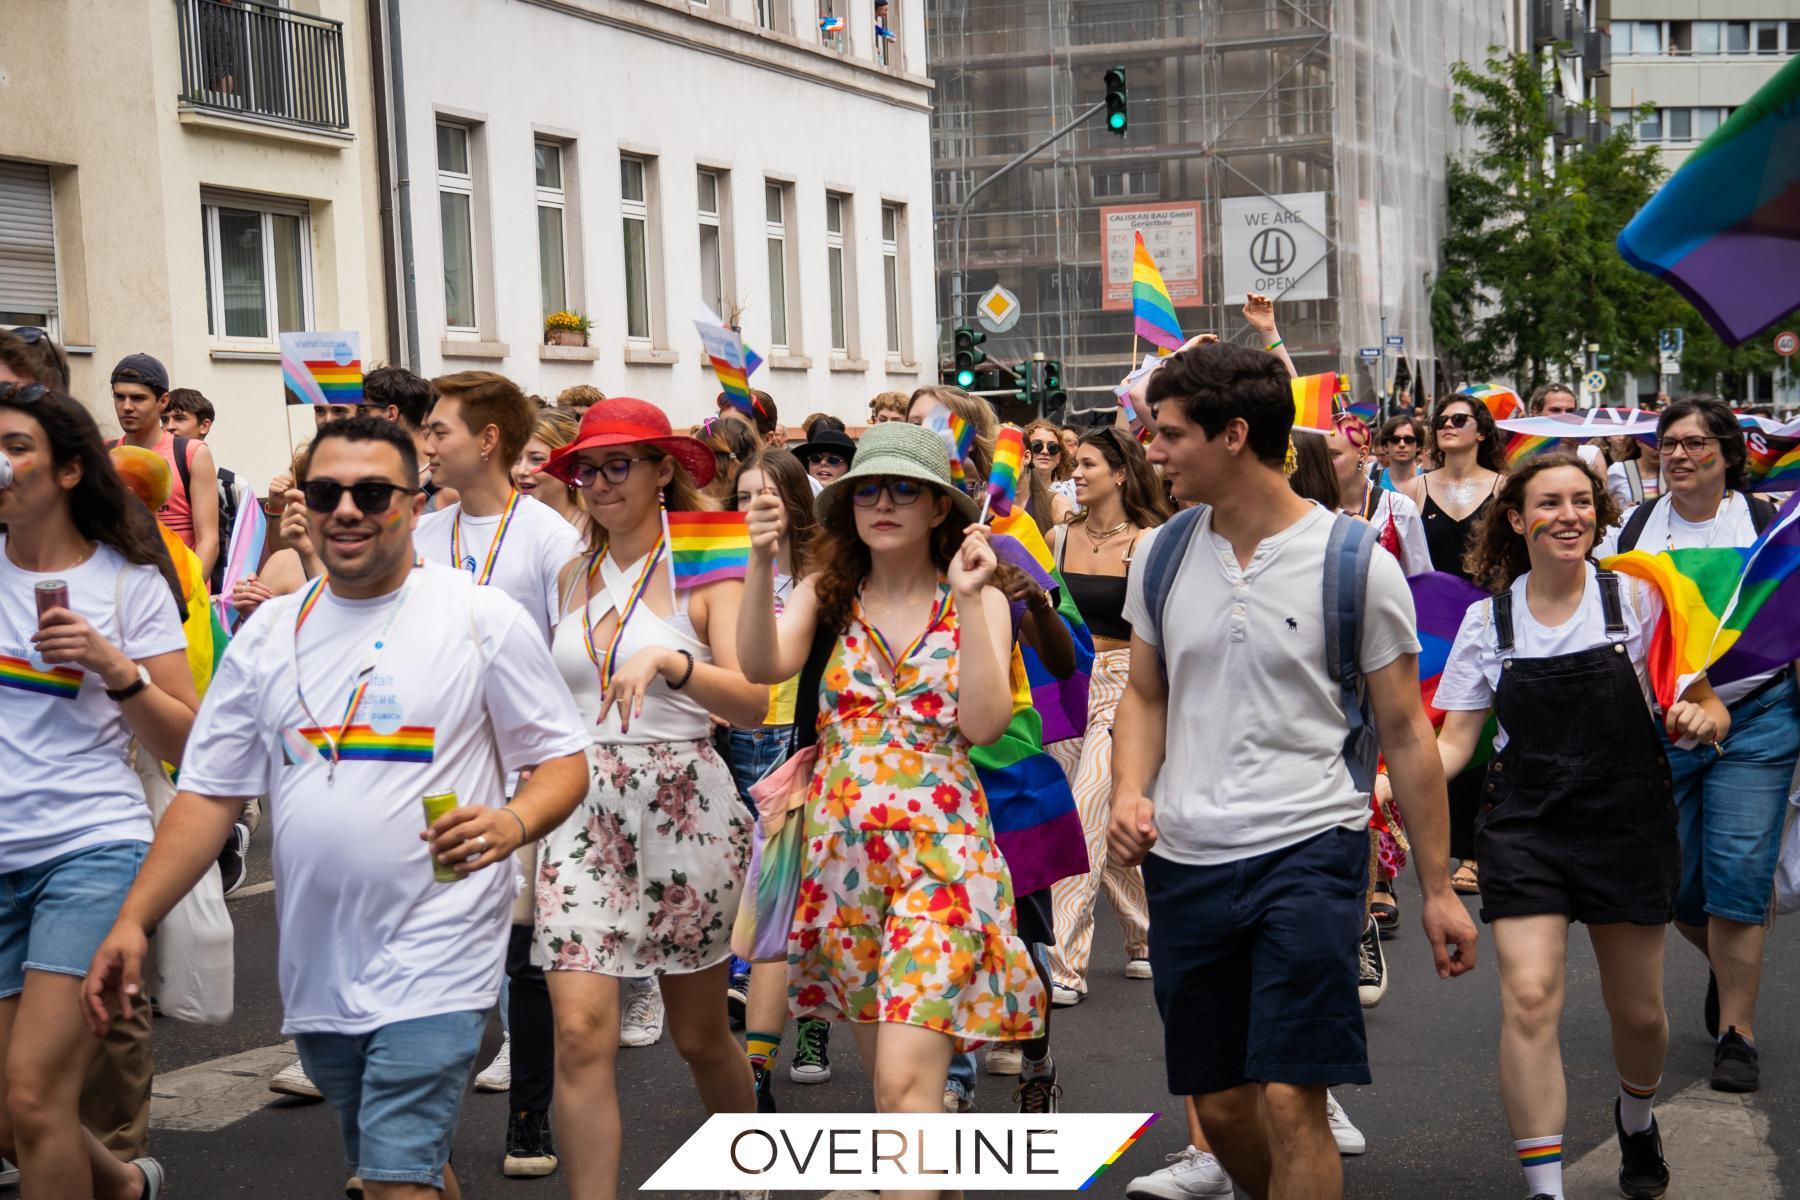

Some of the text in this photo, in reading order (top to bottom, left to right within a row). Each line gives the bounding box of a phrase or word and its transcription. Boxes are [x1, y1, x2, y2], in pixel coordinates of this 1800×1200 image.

[1150, 212, 1169, 220] BAU
[1169, 210, 1194, 219] GmbH
[1244, 210, 1302, 227] WE ARE
[1254, 276, 1297, 292] OPEN
[1779, 338, 1794, 348] 40
